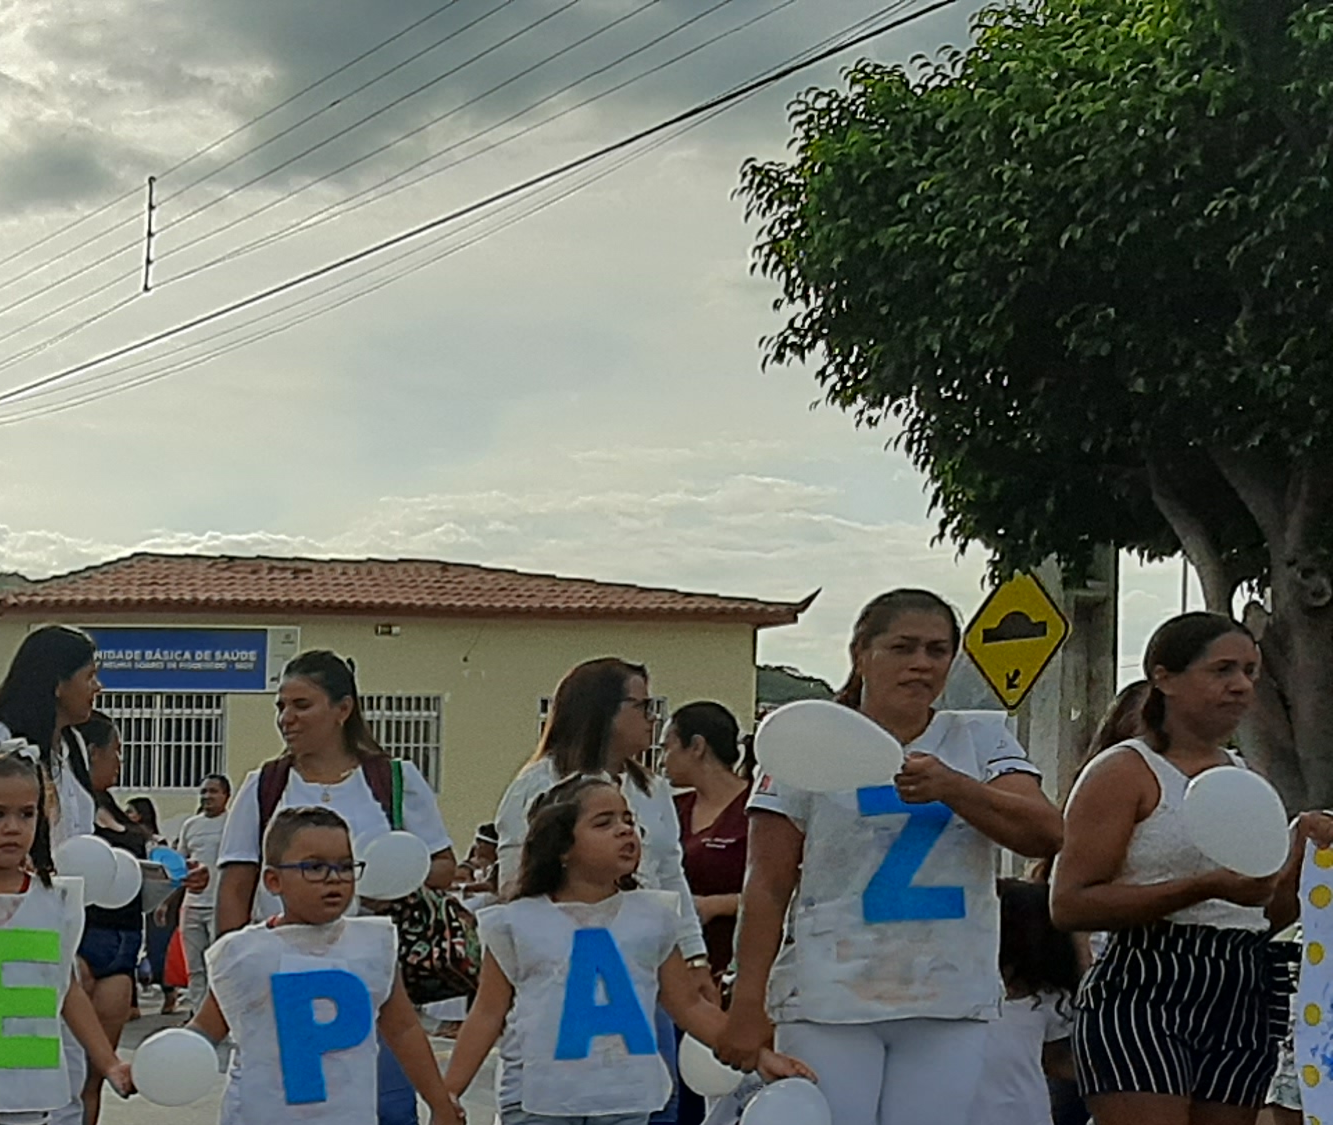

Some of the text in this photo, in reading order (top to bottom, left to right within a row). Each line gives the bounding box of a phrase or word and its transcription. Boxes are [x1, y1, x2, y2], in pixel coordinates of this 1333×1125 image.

[93, 648, 257, 661] NIDADE BÁSICA DE SAÚDE
[856, 784, 967, 924] Z
[269, 968, 374, 1105] P
[553, 927, 662, 1061] A
